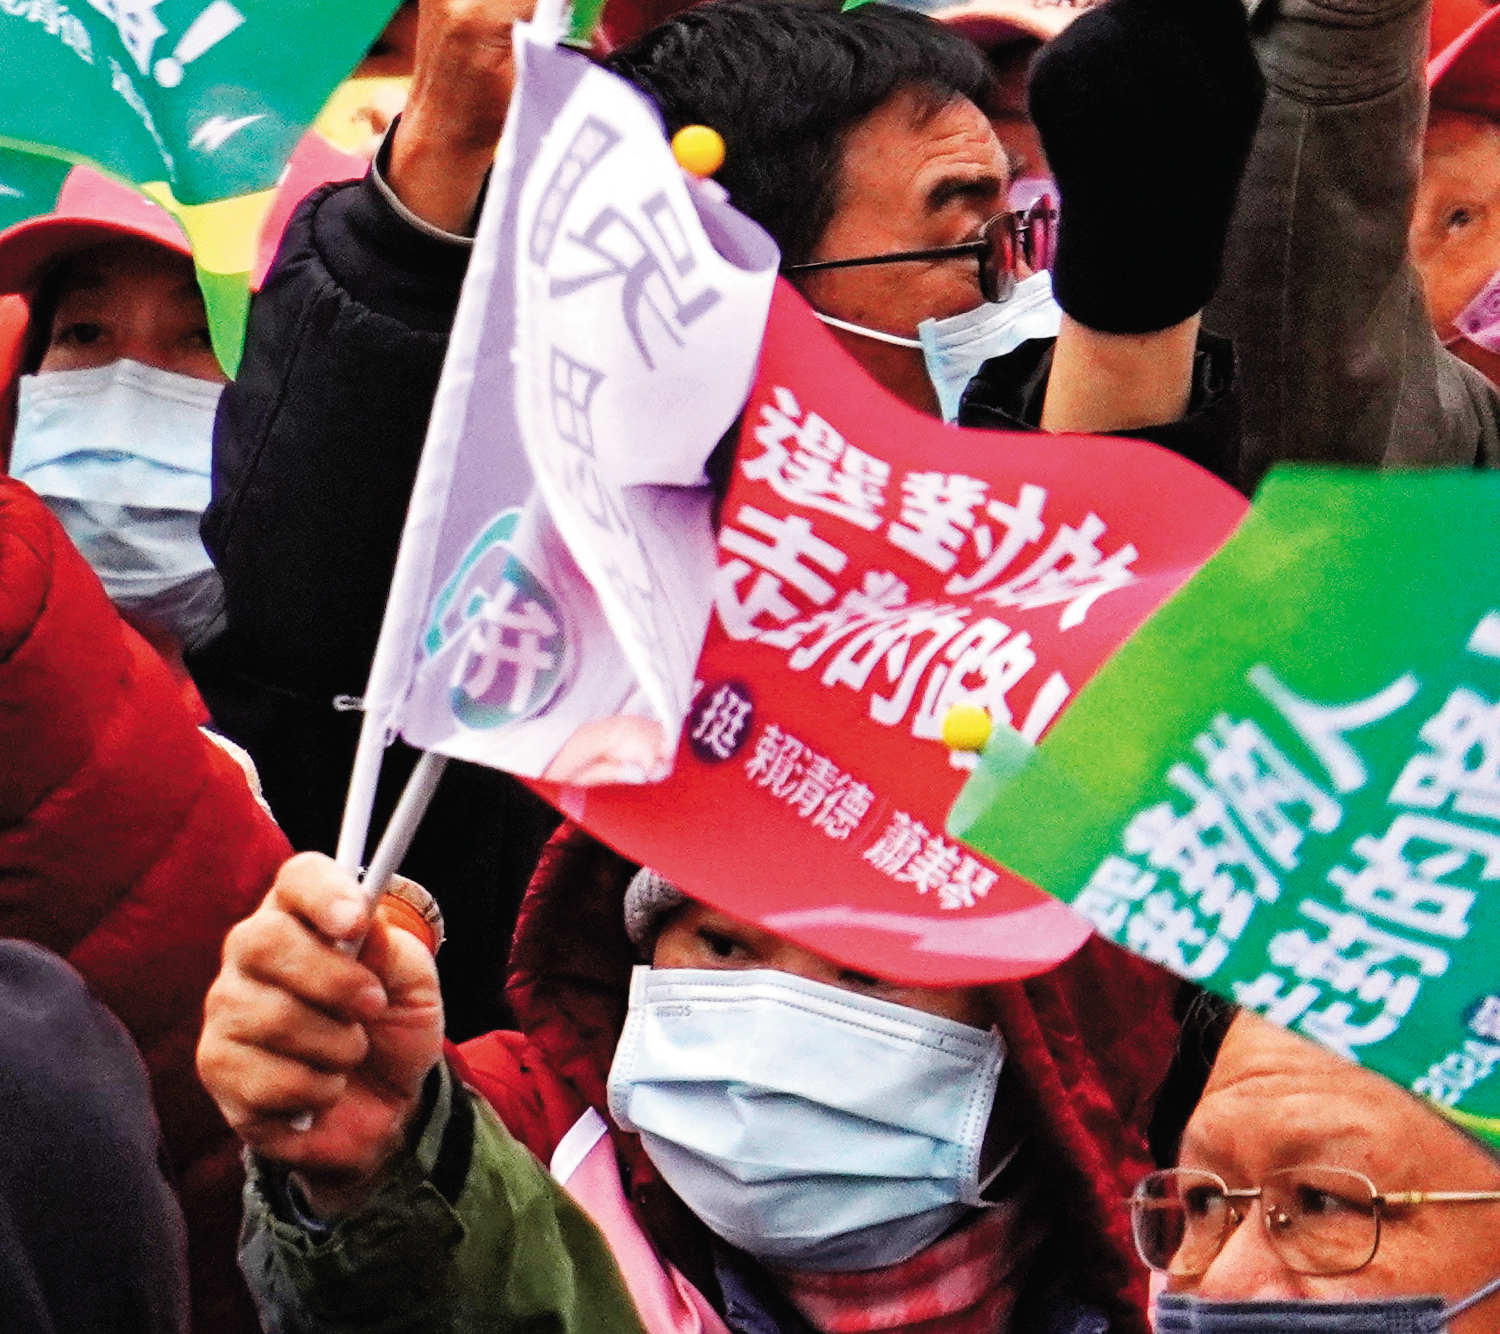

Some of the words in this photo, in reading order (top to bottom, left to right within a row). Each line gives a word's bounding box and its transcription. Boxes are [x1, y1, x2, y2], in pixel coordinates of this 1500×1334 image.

[692, 683, 750, 764] 挺
[743, 727, 877, 847] 賴清德
[864, 809, 998, 914] 蕭美琴
